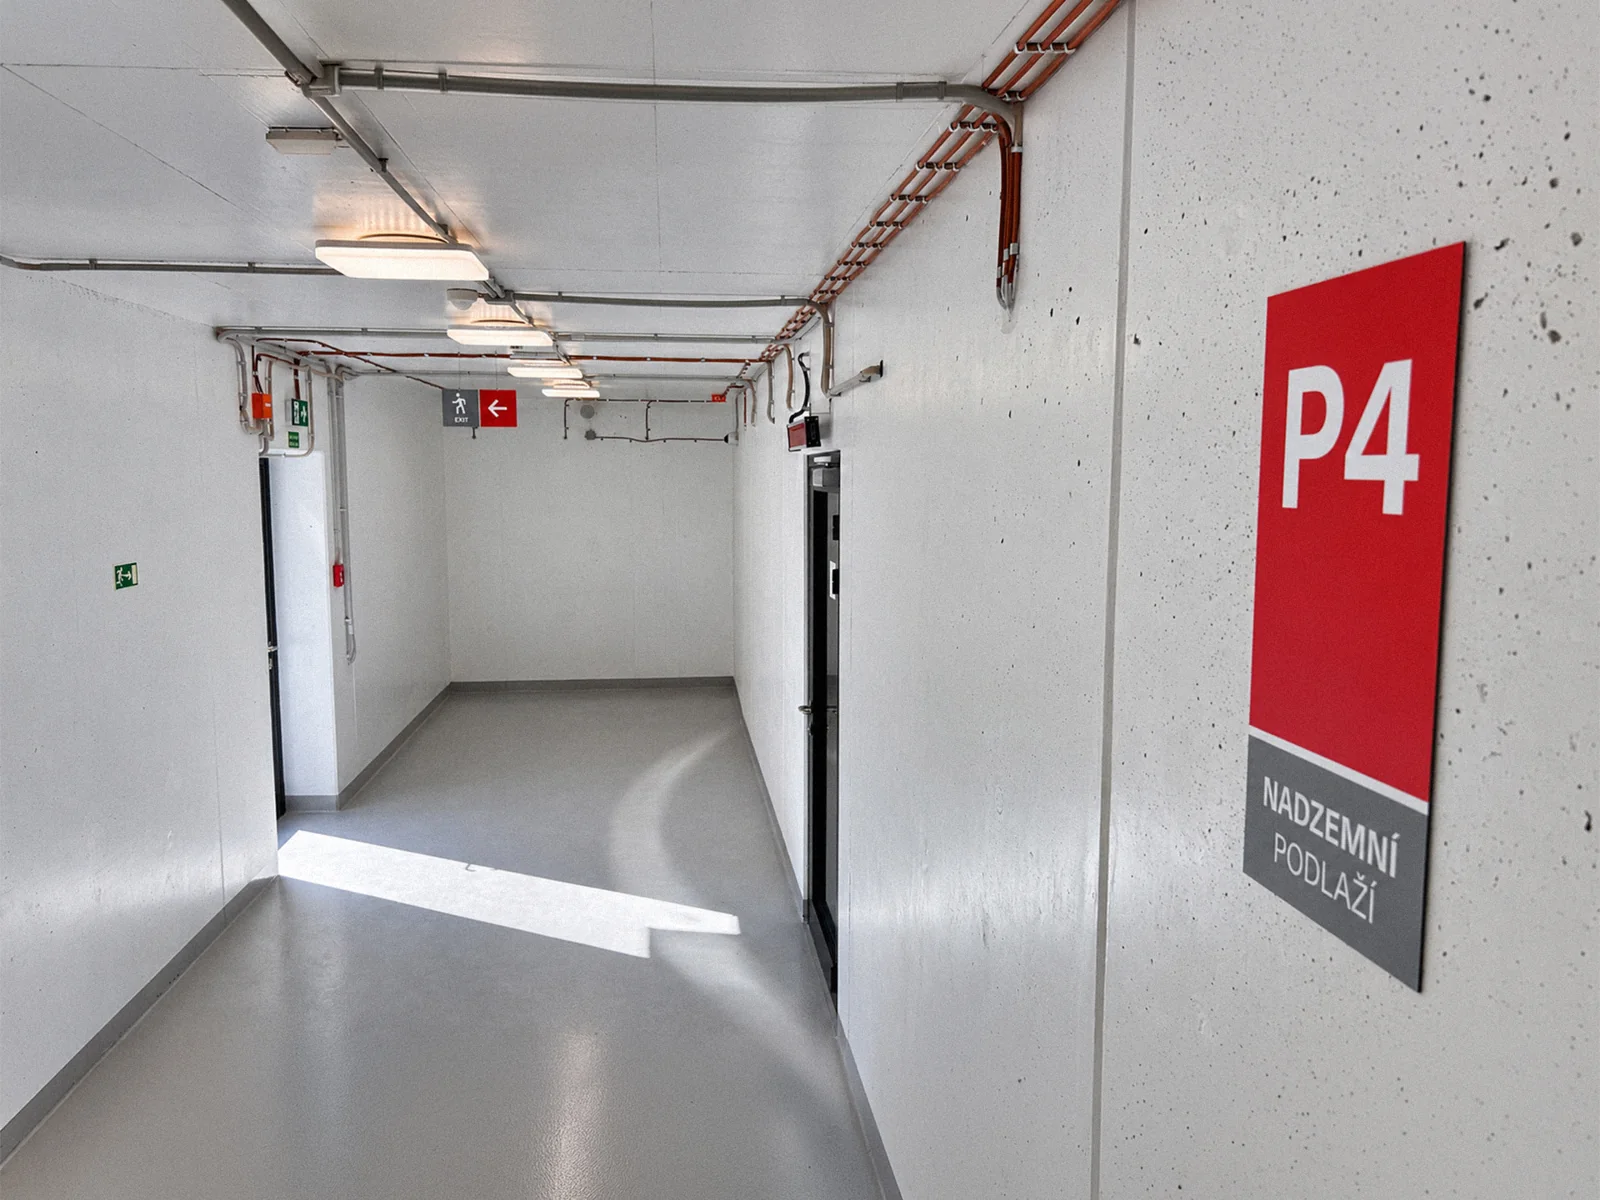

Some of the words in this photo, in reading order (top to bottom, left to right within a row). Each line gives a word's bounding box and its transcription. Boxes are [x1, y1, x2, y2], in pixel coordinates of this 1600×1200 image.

[1282, 359, 1420, 515] P4
[1263, 776, 1400, 878] NADZEMNÍ
[1274, 832, 1377, 924] PODLAŽÍ
